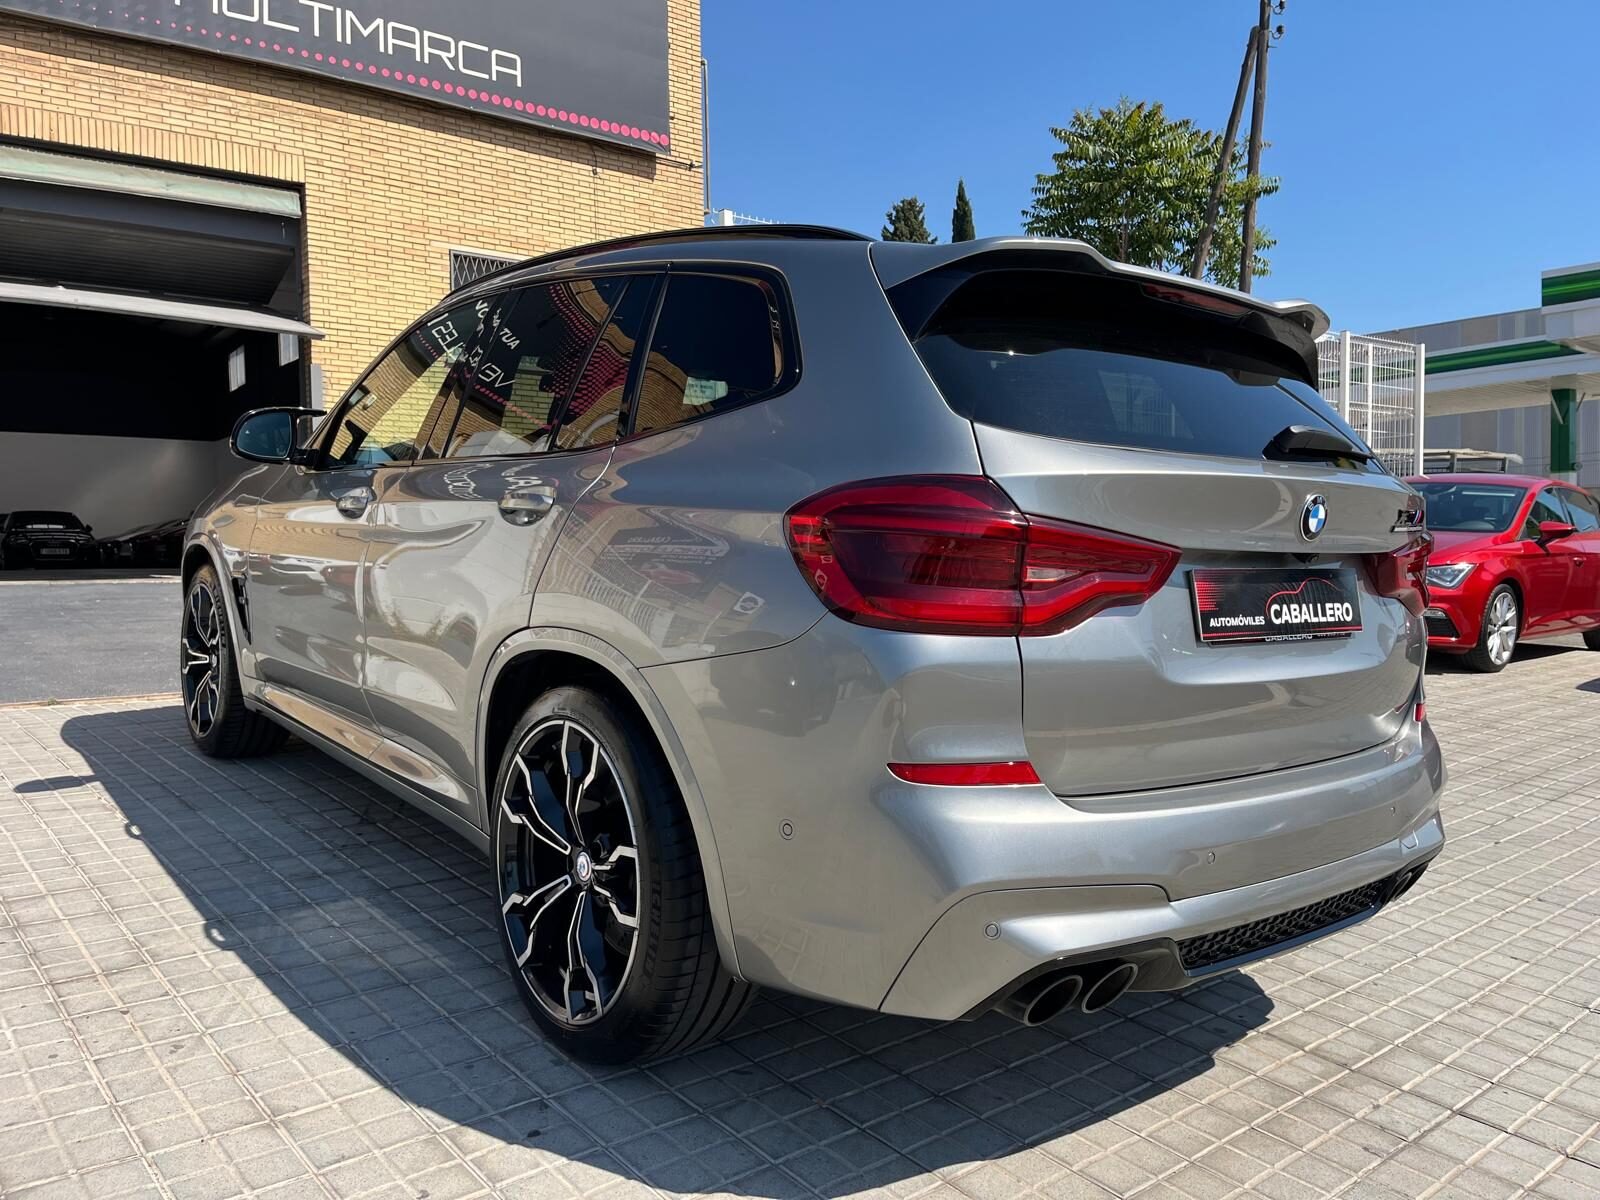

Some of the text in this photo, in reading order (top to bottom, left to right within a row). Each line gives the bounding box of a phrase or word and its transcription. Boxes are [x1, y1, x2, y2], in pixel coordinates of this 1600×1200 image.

[175, 0, 522, 87] ULTIMARCA
[1210, 602, 1353, 627] AUTOMÓVILES CABALLERO
